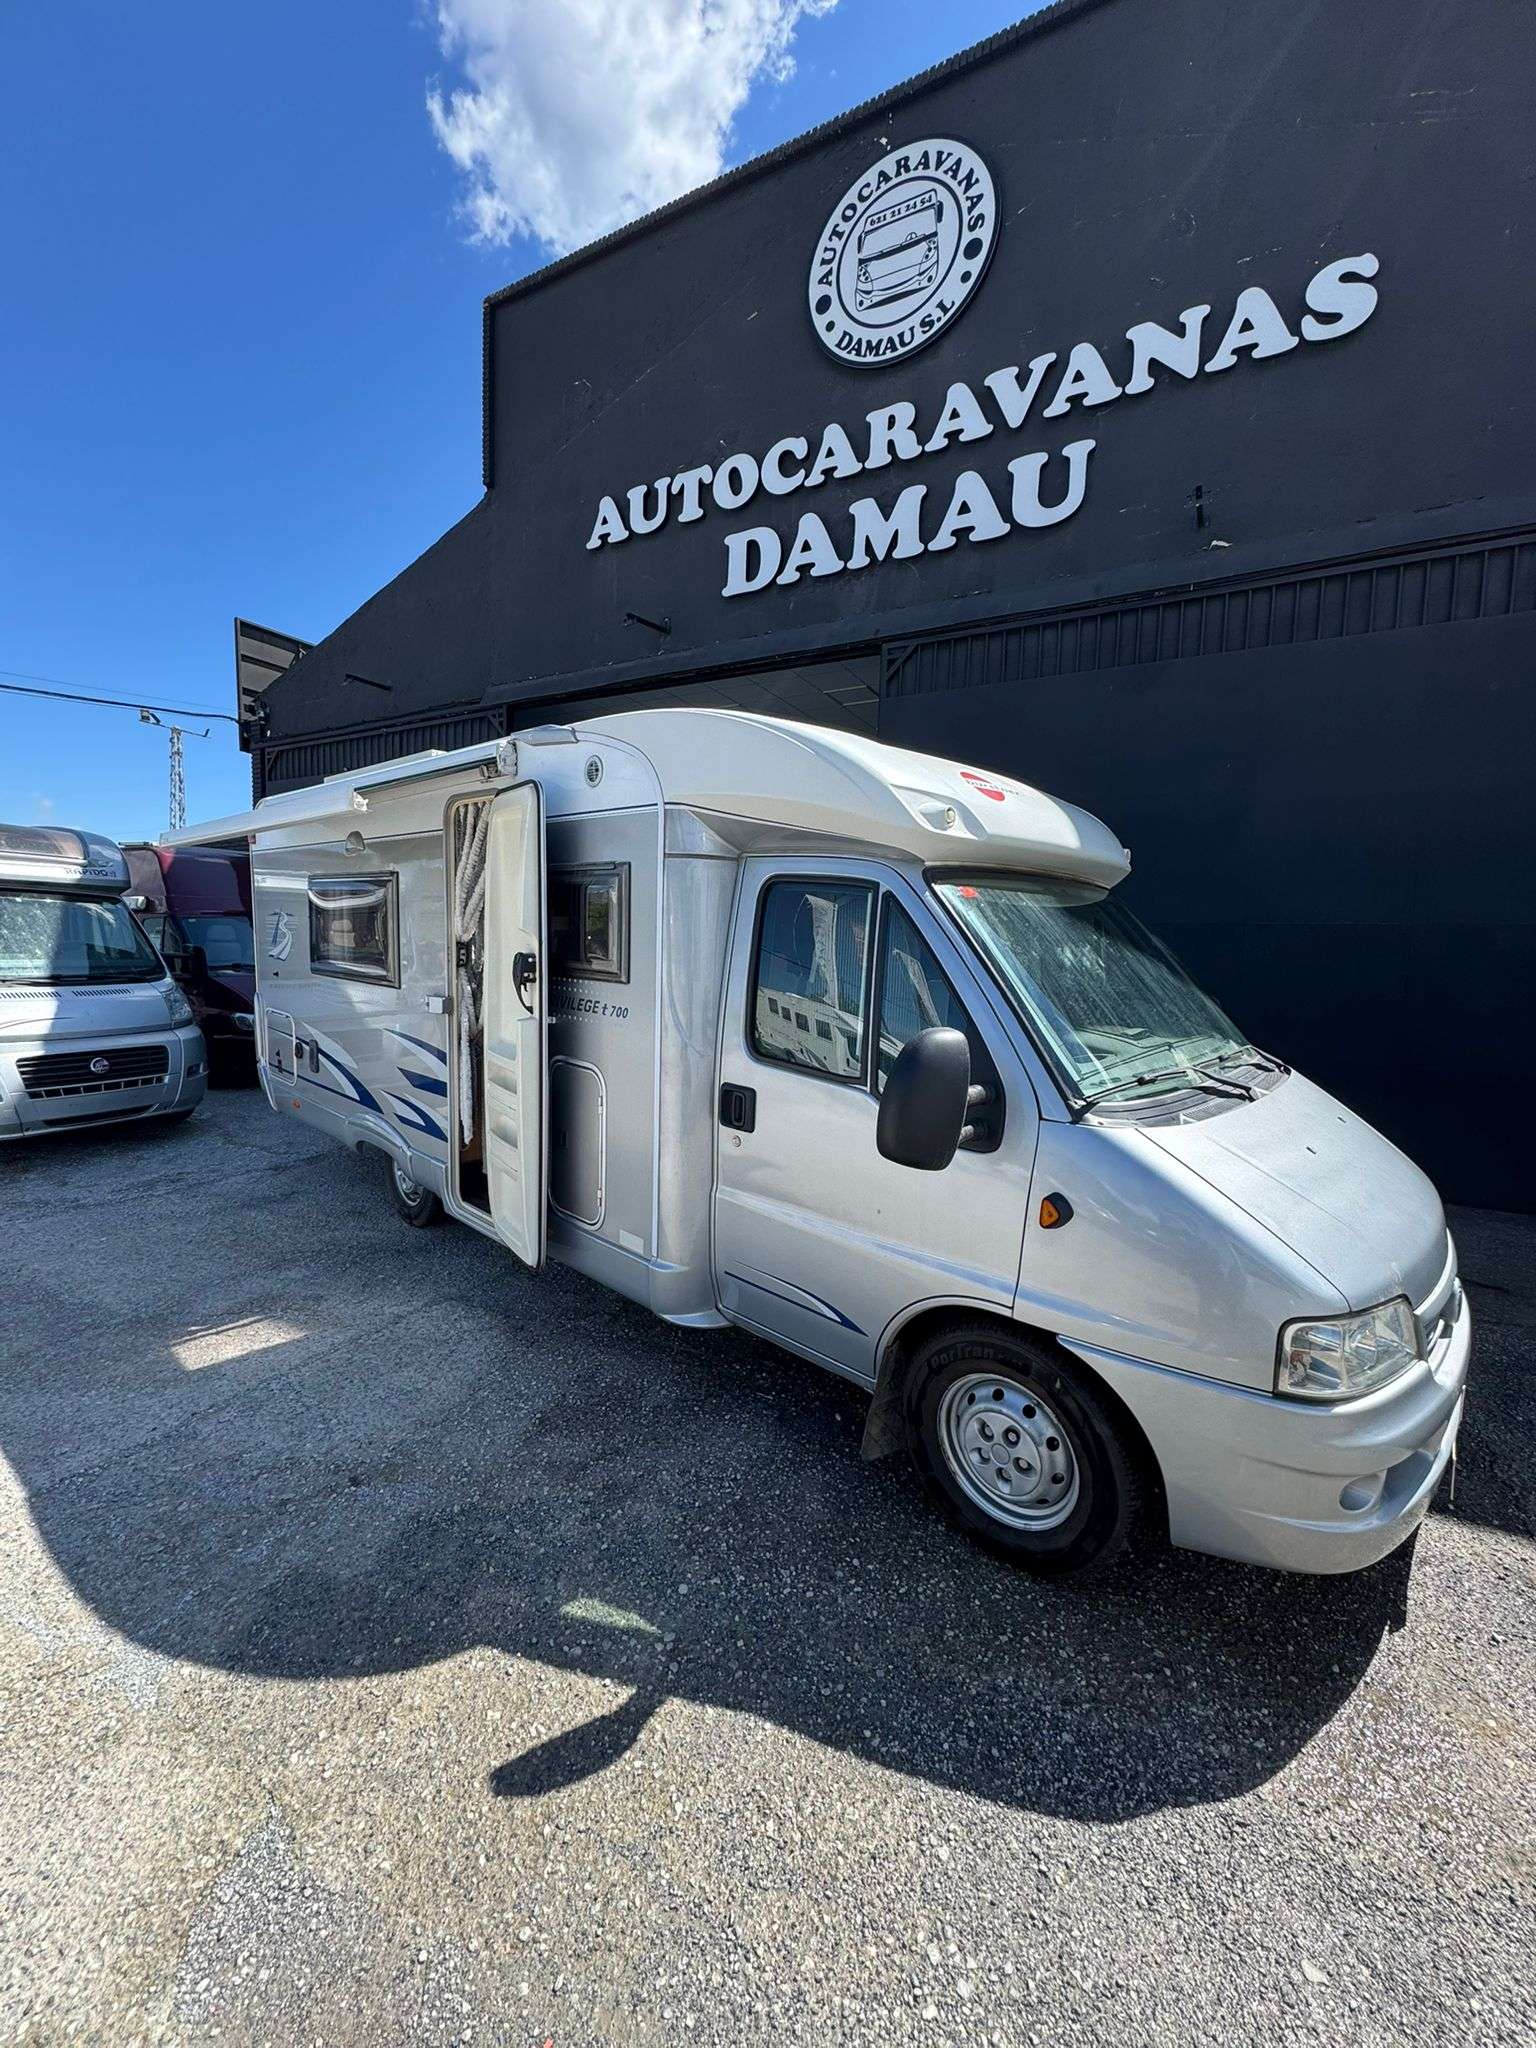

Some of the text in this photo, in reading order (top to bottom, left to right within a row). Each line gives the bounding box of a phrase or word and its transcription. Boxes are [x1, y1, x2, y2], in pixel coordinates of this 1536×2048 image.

[817, 150, 986, 288] AUTOCARAVANAS
[586, 253, 1380, 550] AUTOCARAVANAS
[835, 325, 916, 358] DAMAU
[722, 439, 1096, 597] DAMAU
[609, 1005, 629, 1018] 700
